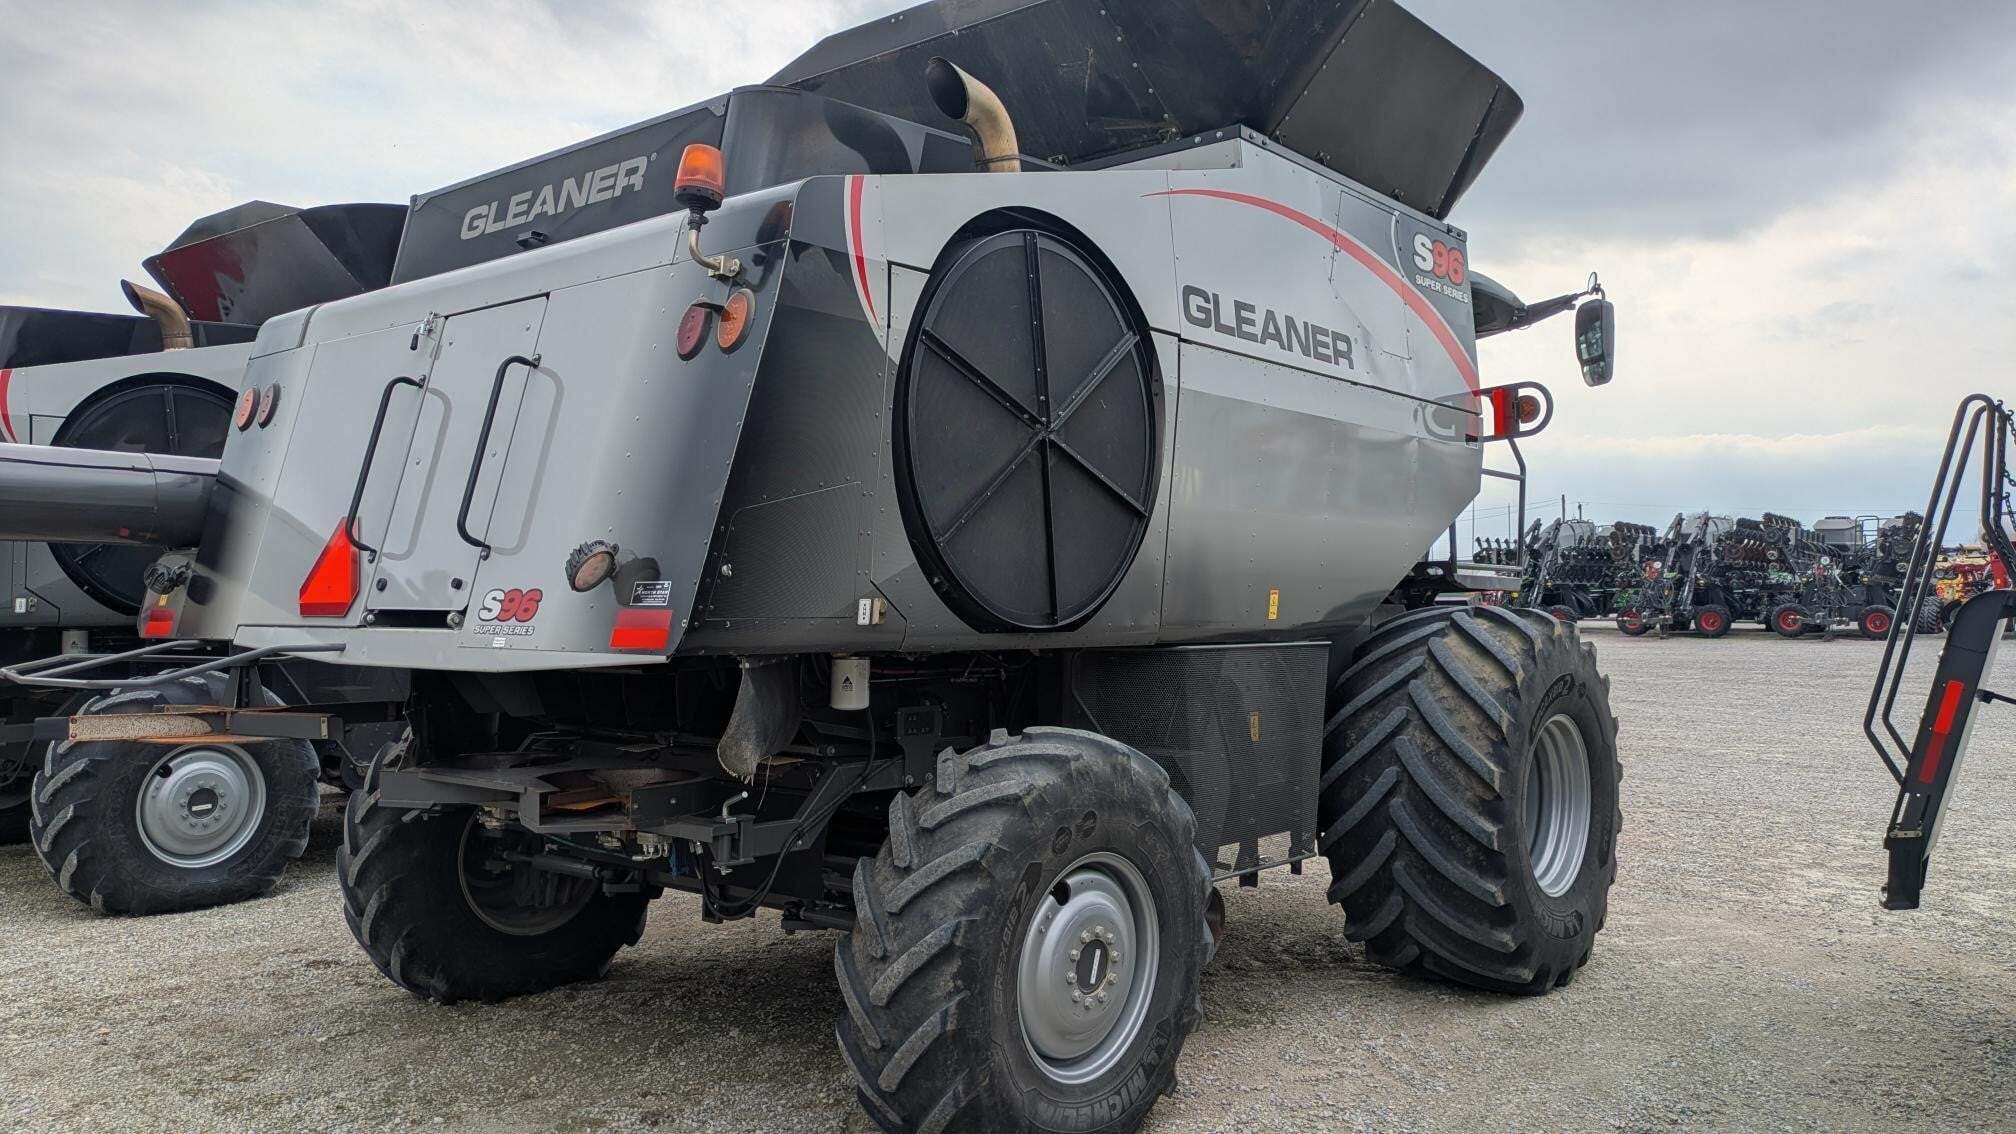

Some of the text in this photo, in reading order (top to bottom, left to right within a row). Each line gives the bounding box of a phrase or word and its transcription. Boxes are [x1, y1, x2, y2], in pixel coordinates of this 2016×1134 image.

[460, 155, 648, 241] GLEANER
[1412, 231, 1465, 287] S96
[1415, 273, 1469, 304] SUPER SERIES
[1182, 284, 1355, 370] GLEANER
[478, 588, 543, 623] S96
[474, 625, 536, 636] SUPER SERIES
